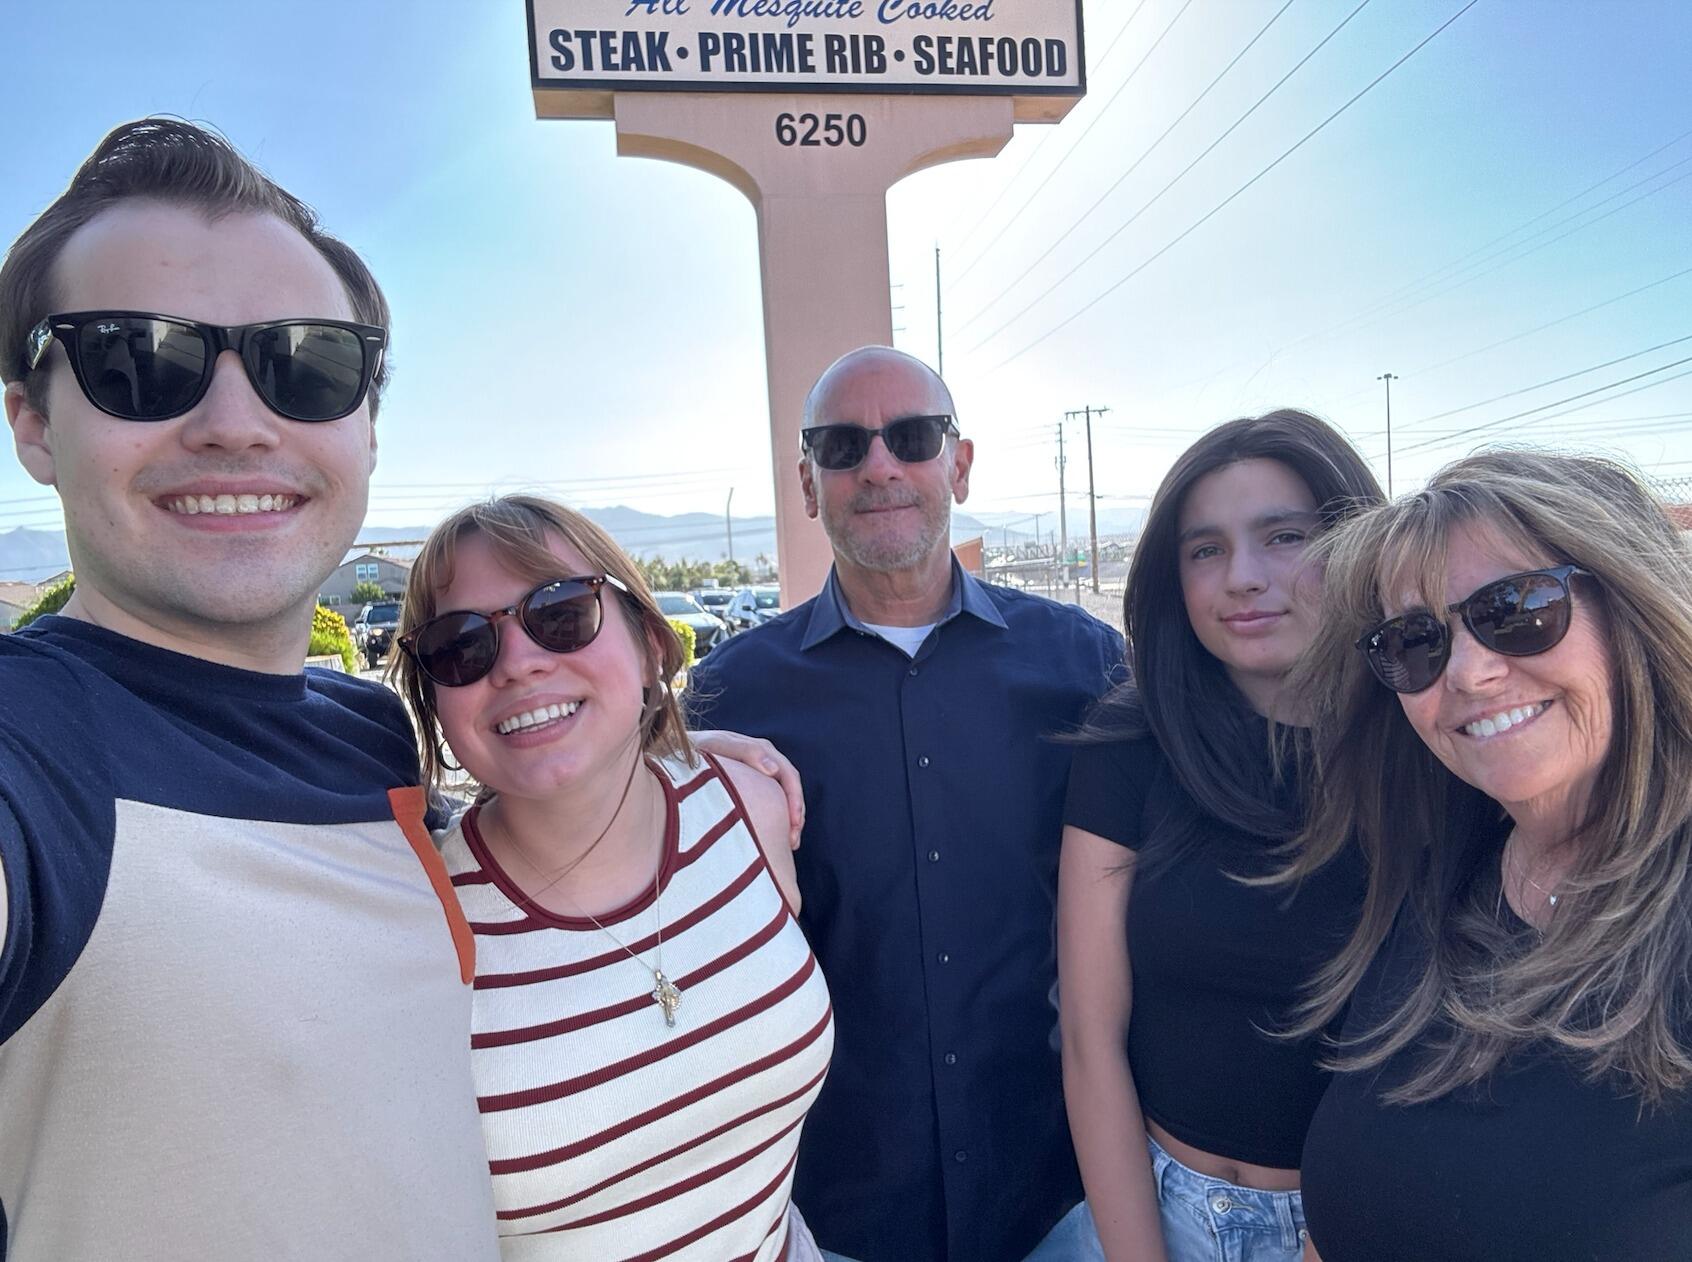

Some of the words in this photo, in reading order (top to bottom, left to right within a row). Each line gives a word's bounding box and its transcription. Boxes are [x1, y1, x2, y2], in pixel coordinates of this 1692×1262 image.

[877, 0, 995, 24] Cooked
[549, 29, 673, 72] STEAK
[698, 32, 817, 74] PRIME
[824, 33, 887, 75] RIB
[912, 35, 1068, 78] SEAFOOD
[776, 112, 867, 147] 6250
